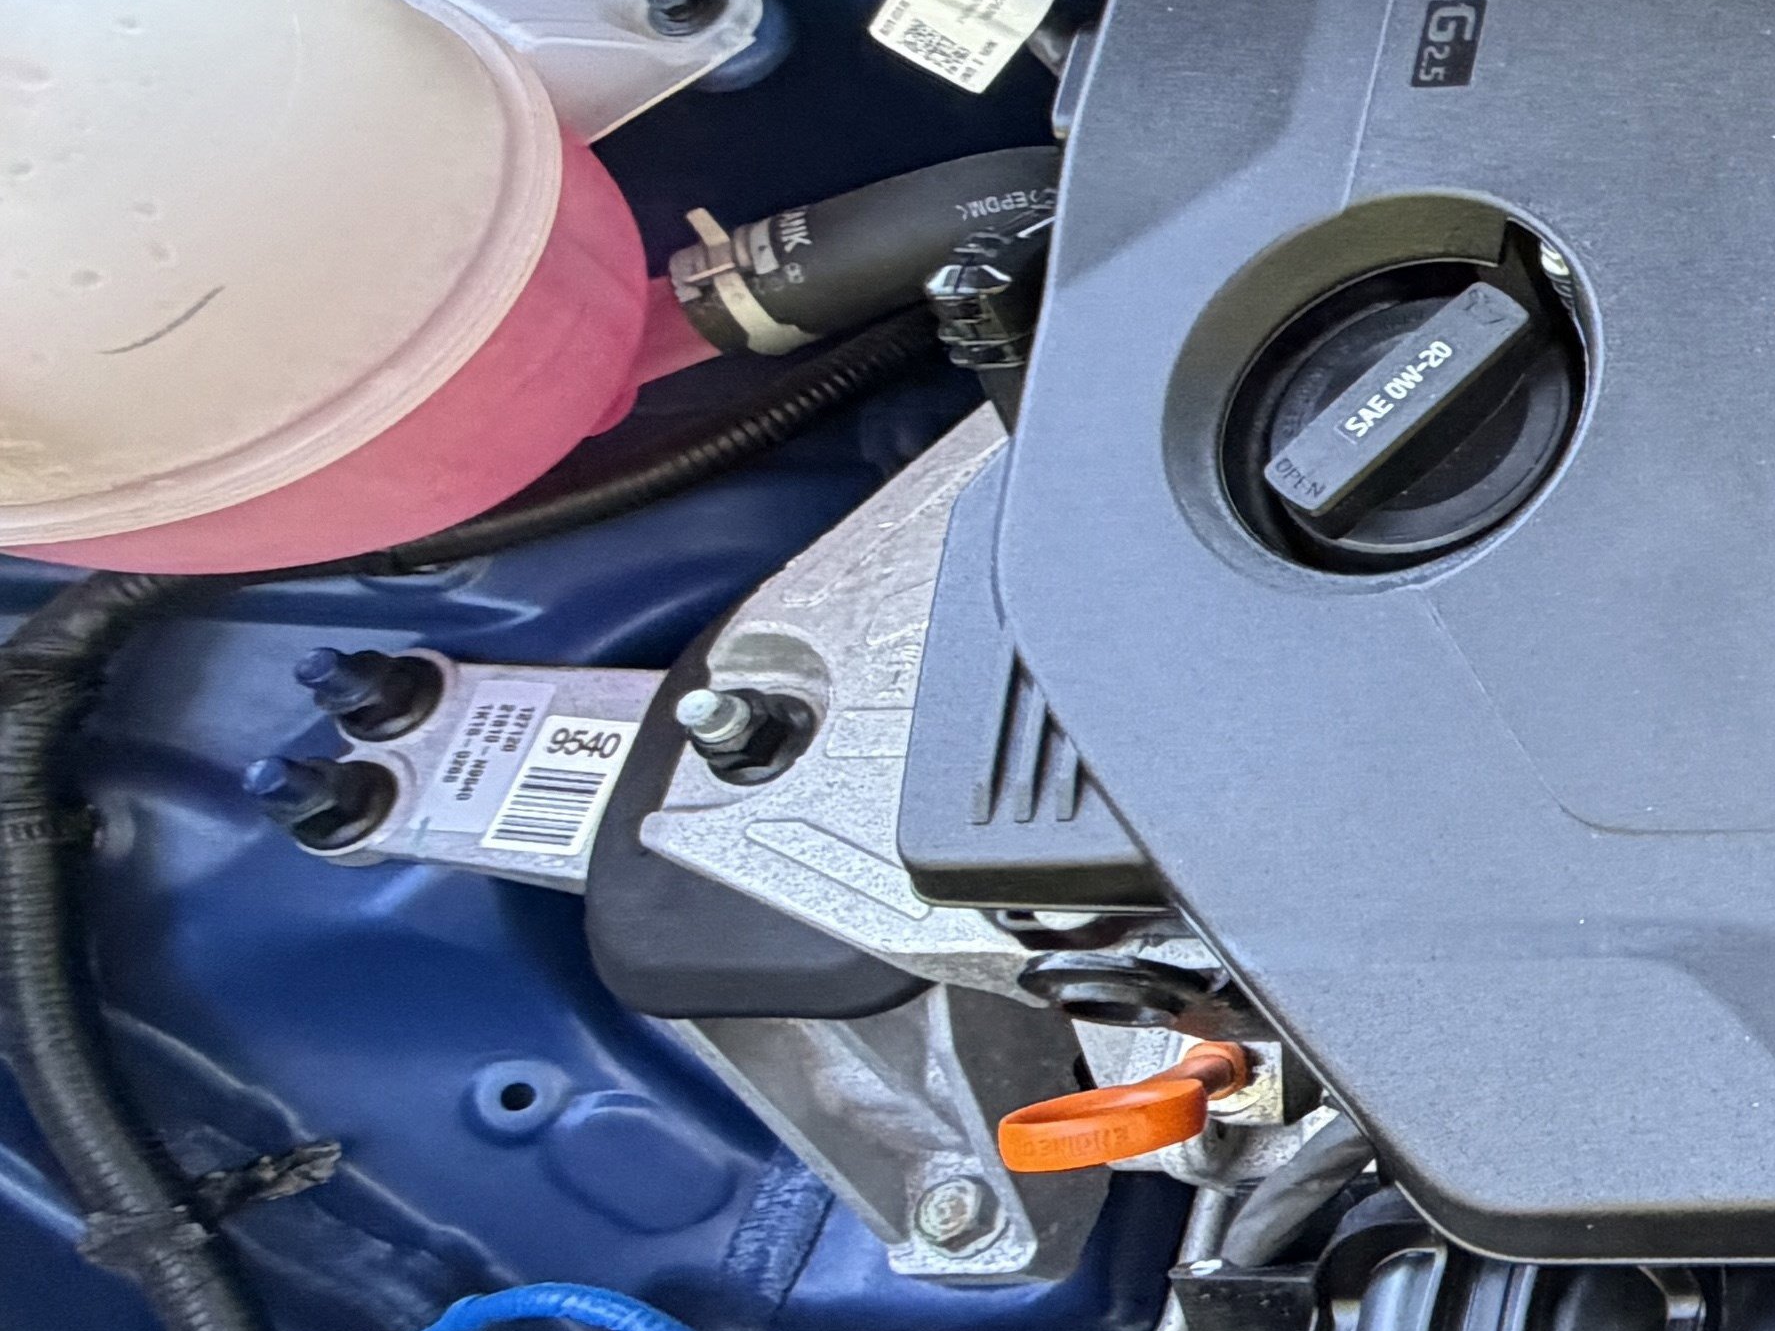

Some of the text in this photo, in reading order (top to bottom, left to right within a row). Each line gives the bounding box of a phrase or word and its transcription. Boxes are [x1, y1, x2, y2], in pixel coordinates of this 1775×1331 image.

[1344, 340, 1453, 440] SAE 0W-20
[1274, 455, 1326, 498] OPEN
[545, 725, 623, 760] 9540
